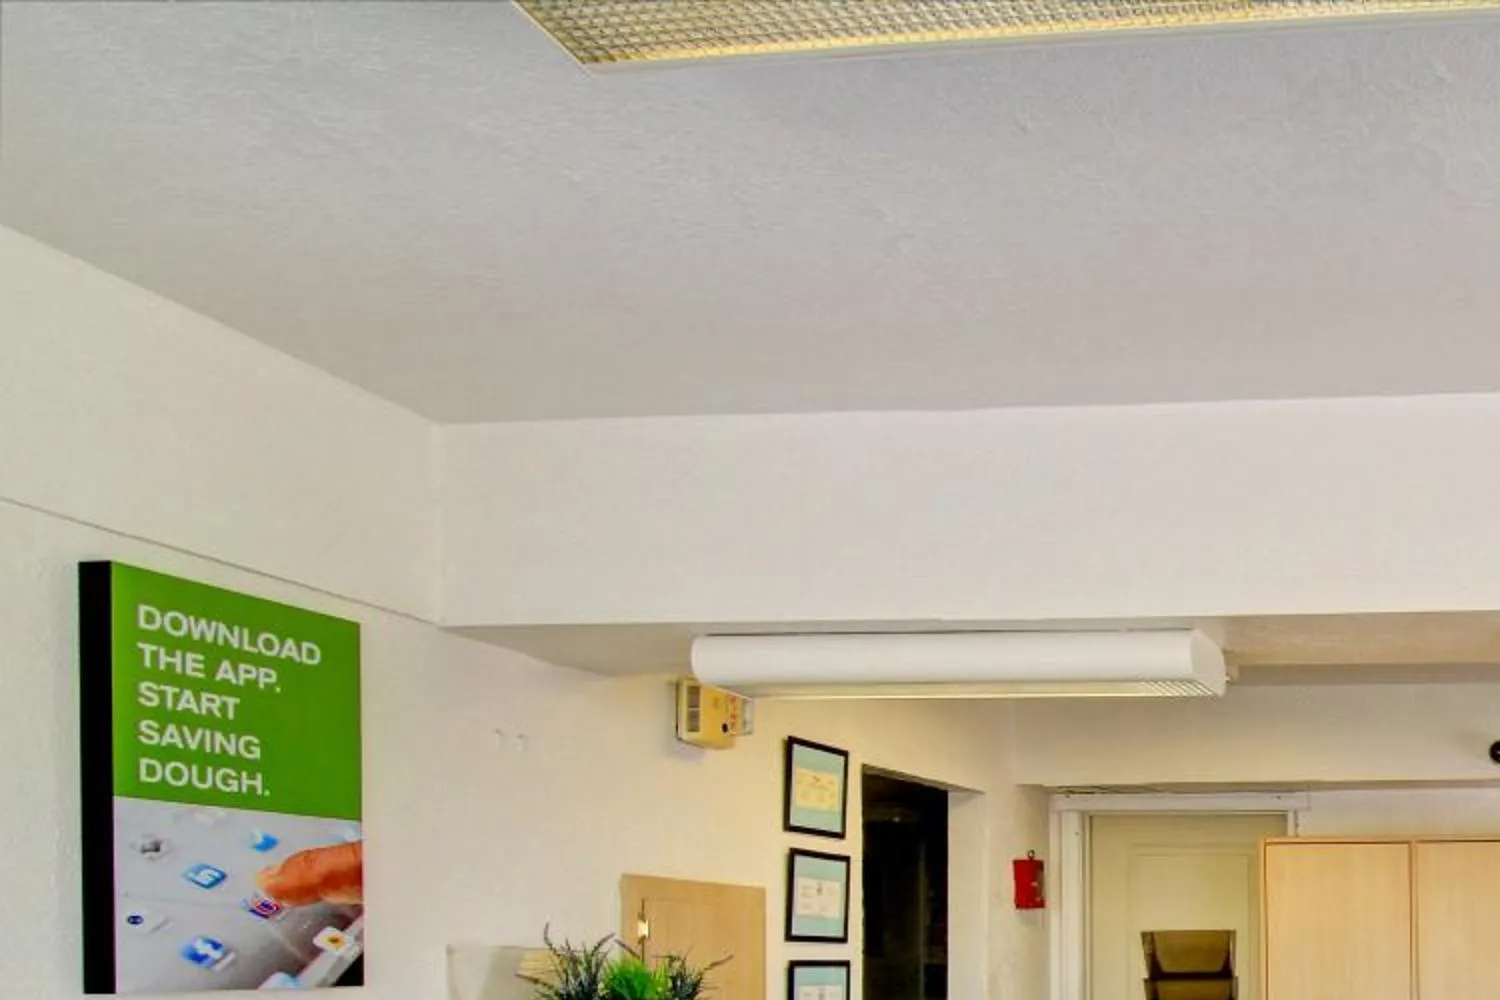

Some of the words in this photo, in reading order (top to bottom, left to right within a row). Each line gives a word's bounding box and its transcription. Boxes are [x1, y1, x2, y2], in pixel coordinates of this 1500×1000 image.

[137, 605, 322, 665] DOWNLOAD
[137, 642, 205, 679] THE
[214, 661, 282, 693] APP.
[138, 681, 240, 721] START
[138, 720, 262, 760] SAVING
[138, 757, 271, 796] DOUGH.
